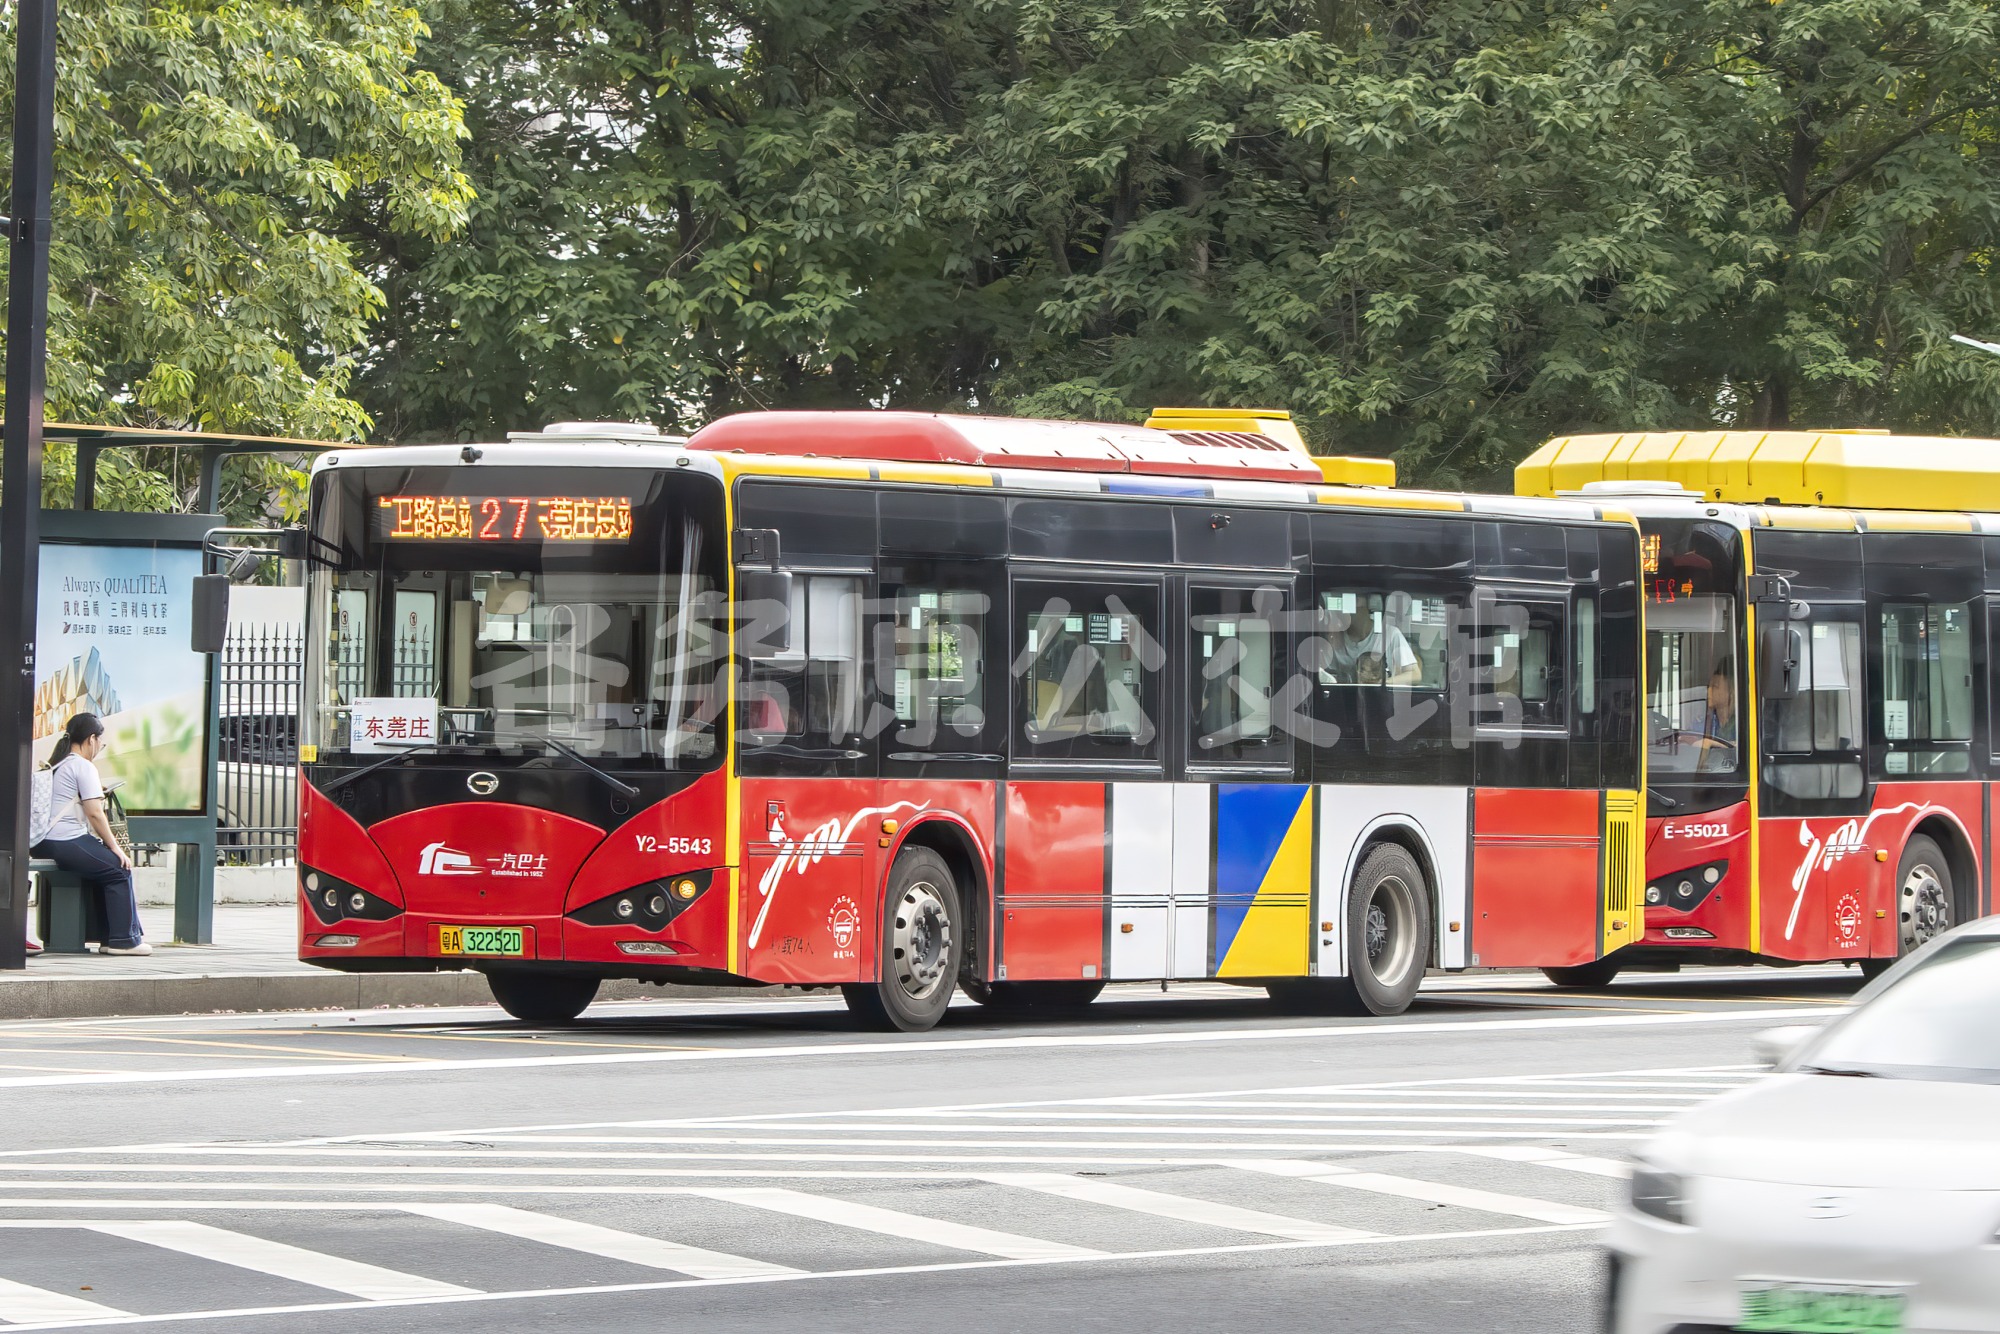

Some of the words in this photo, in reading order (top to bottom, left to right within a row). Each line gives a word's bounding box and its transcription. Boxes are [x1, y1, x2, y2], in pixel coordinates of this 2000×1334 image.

[479, 498, 530, 540] 27
[63, 576, 100, 597] Always
[365, 716, 430, 739] 东莞庄
[1664, 823, 1729, 839] E-55021
[635, 834, 712, 855] Y2-5543
[486, 853, 549, 869] 一汽巴士
